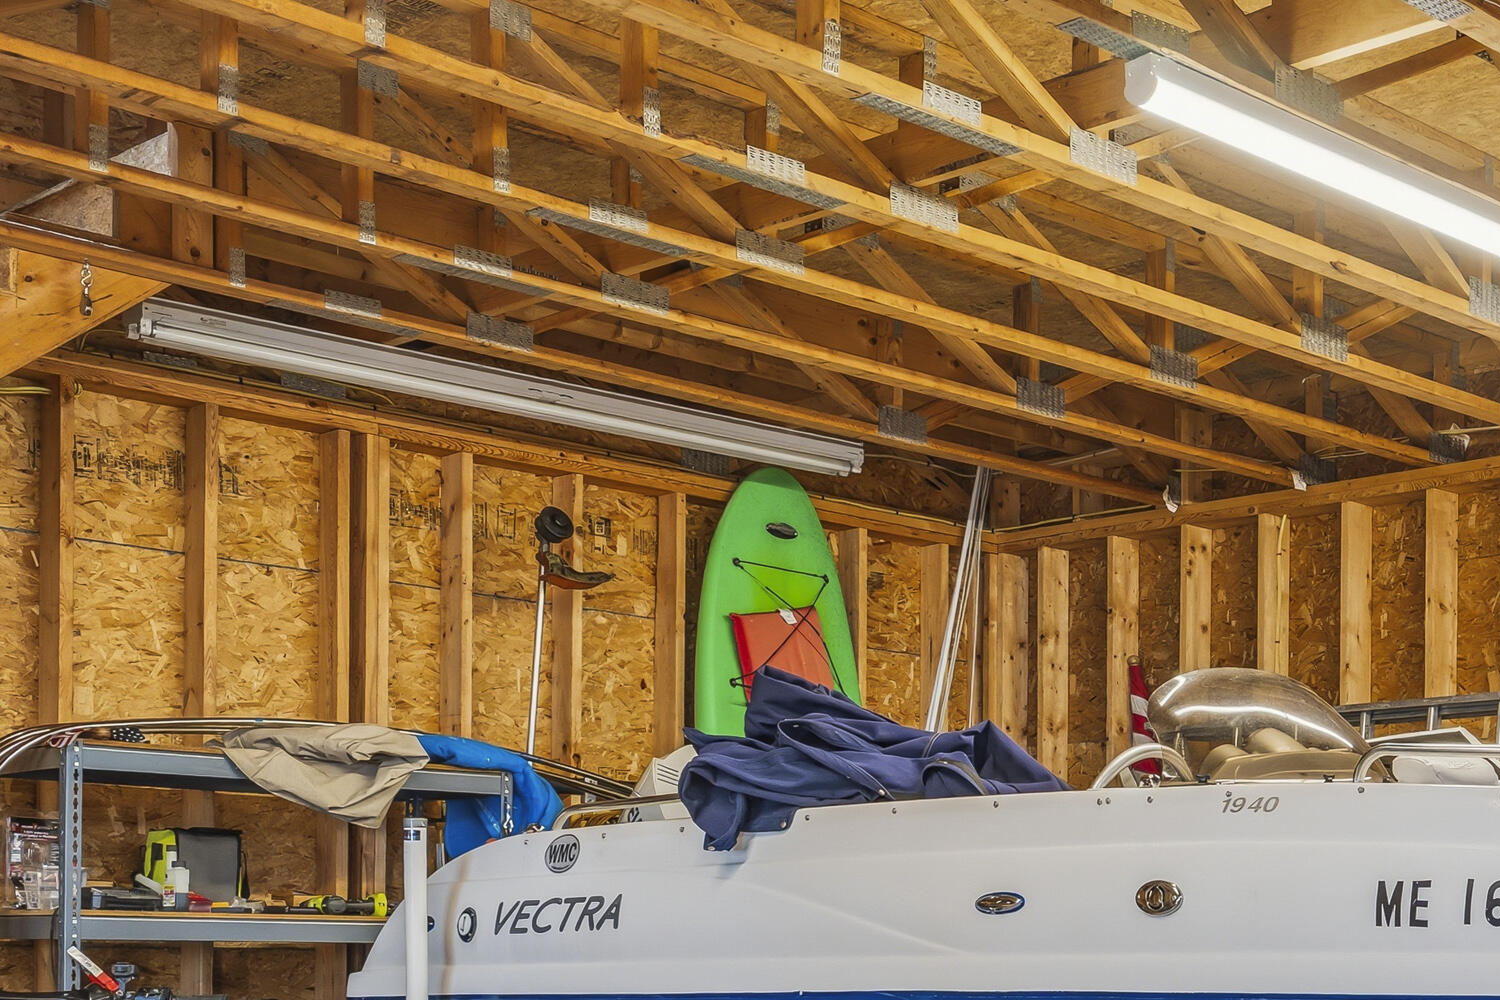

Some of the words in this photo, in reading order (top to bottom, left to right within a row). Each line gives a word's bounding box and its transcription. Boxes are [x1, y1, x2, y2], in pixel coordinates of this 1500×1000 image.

[1222, 796, 1280, 813] 1940
[549, 844, 578, 865] WMC
[494, 893, 623, 936] VECTRA
[1375, 880, 1432, 927] ME
